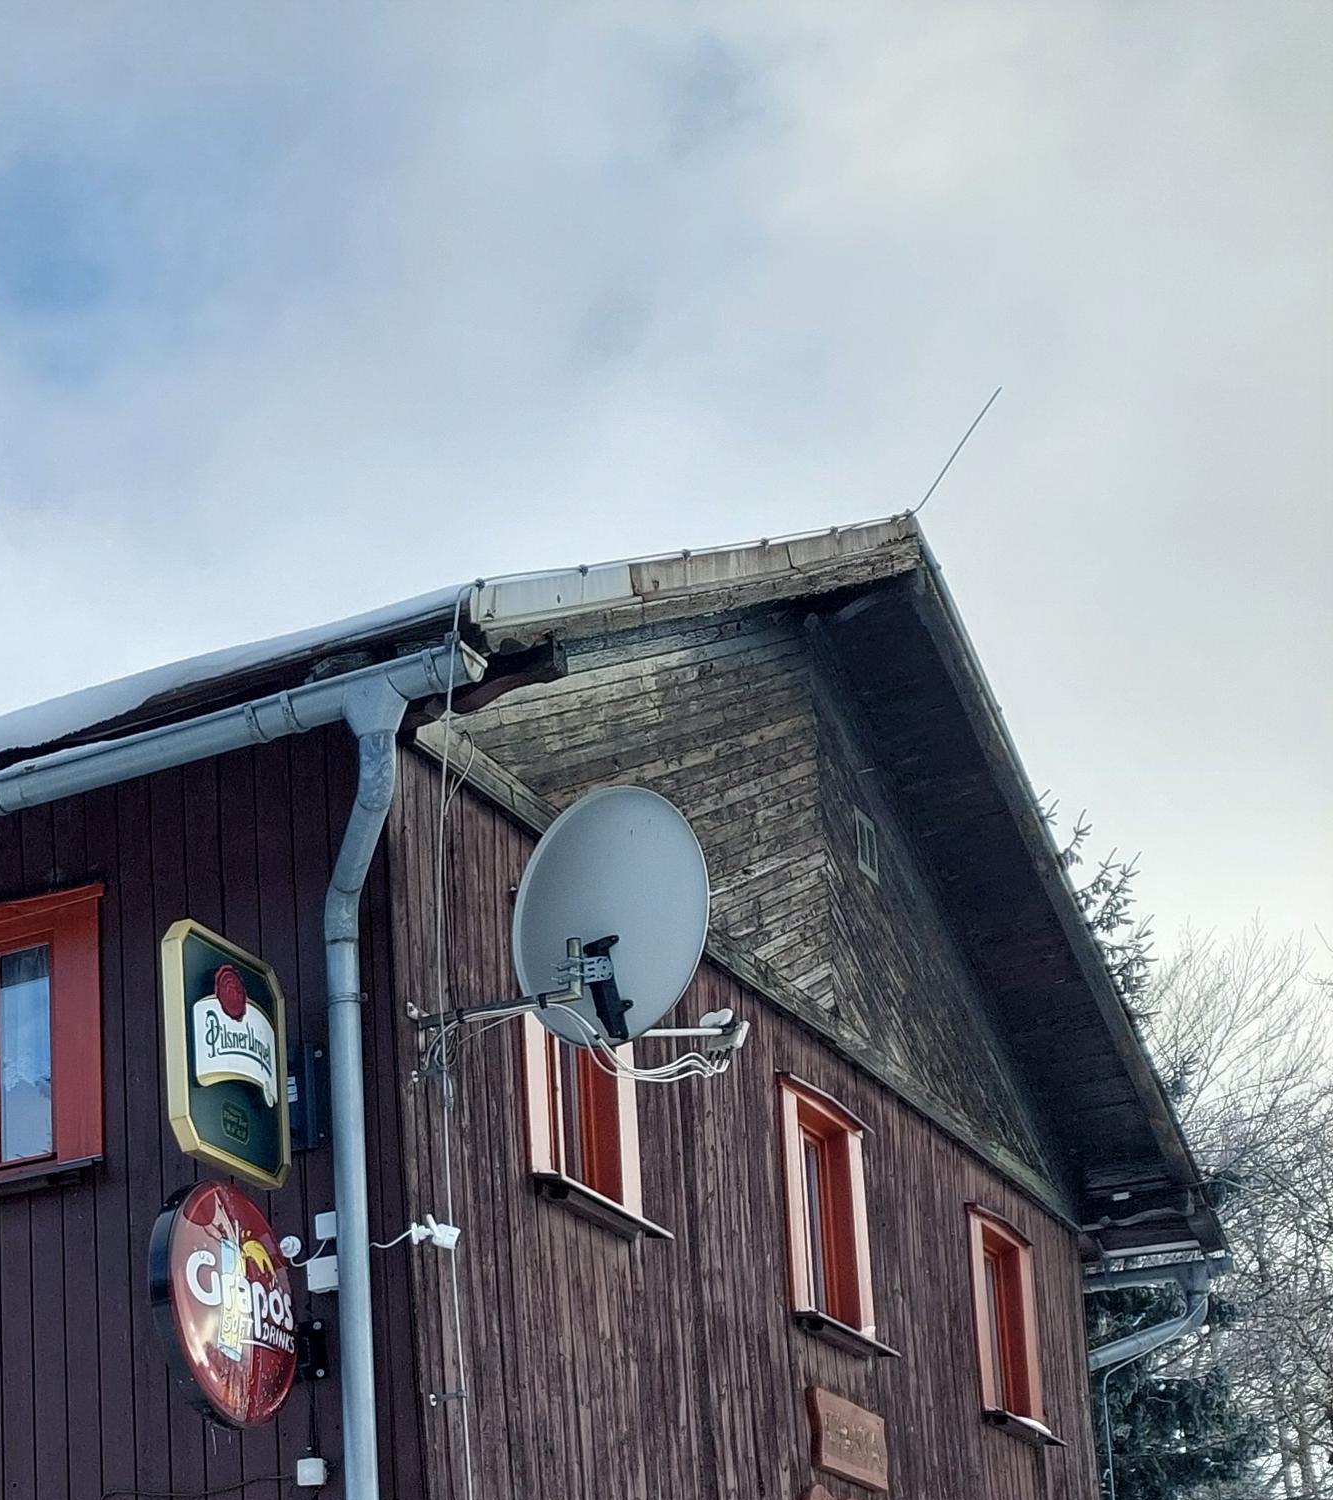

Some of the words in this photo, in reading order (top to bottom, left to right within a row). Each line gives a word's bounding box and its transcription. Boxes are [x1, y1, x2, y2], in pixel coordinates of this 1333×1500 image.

[205, 1009, 247, 1059] Pilsner
[246, 1021, 273, 1071] Urquell
[185, 1249, 294, 1340] Grapos
[222, 1311, 255, 1337] SOFT
[261, 1322, 296, 1355] DRINKS
